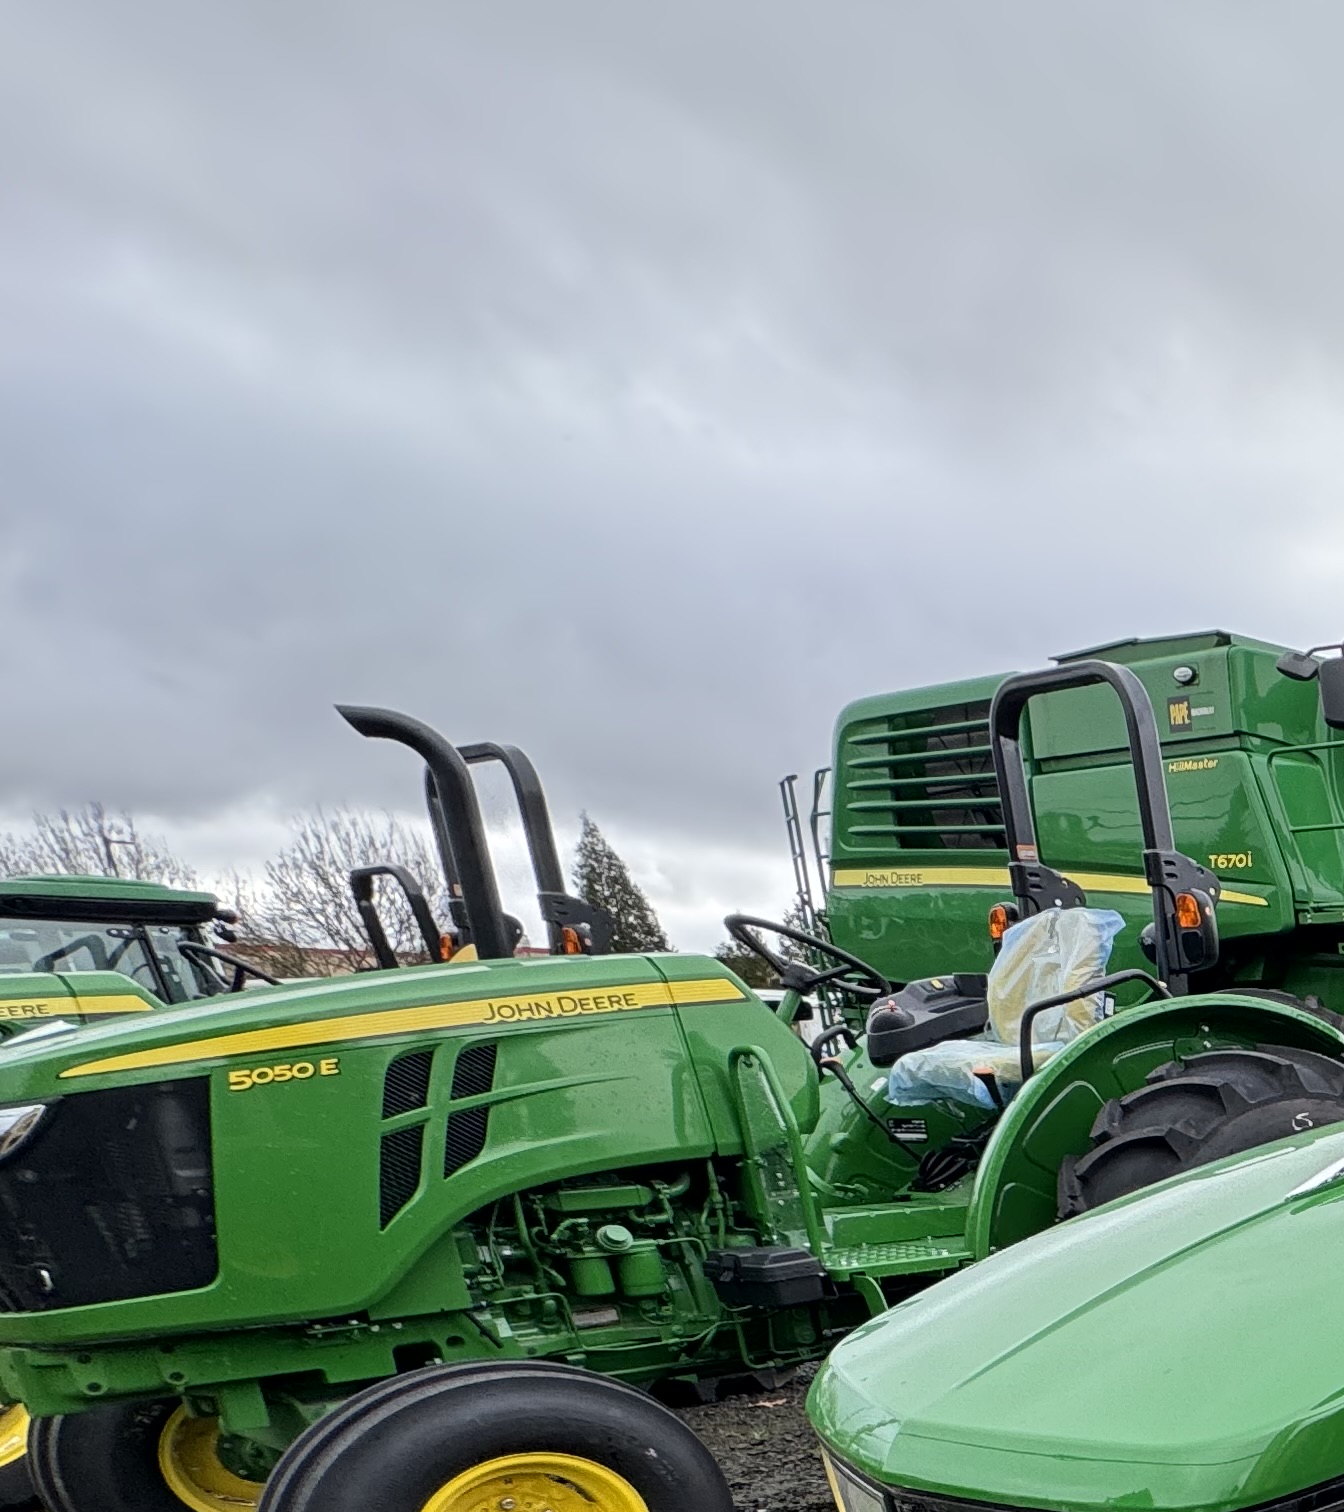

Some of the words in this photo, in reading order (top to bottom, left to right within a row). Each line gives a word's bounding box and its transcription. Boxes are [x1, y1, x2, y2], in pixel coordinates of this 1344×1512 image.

[1208, 850, 1253, 869] T670i
[863, 872, 889, 886] JOHN
[890, 872, 923, 885] DEERE
[483, 1001, 554, 1022] JOHN
[556, 992, 640, 1014] DEERE
